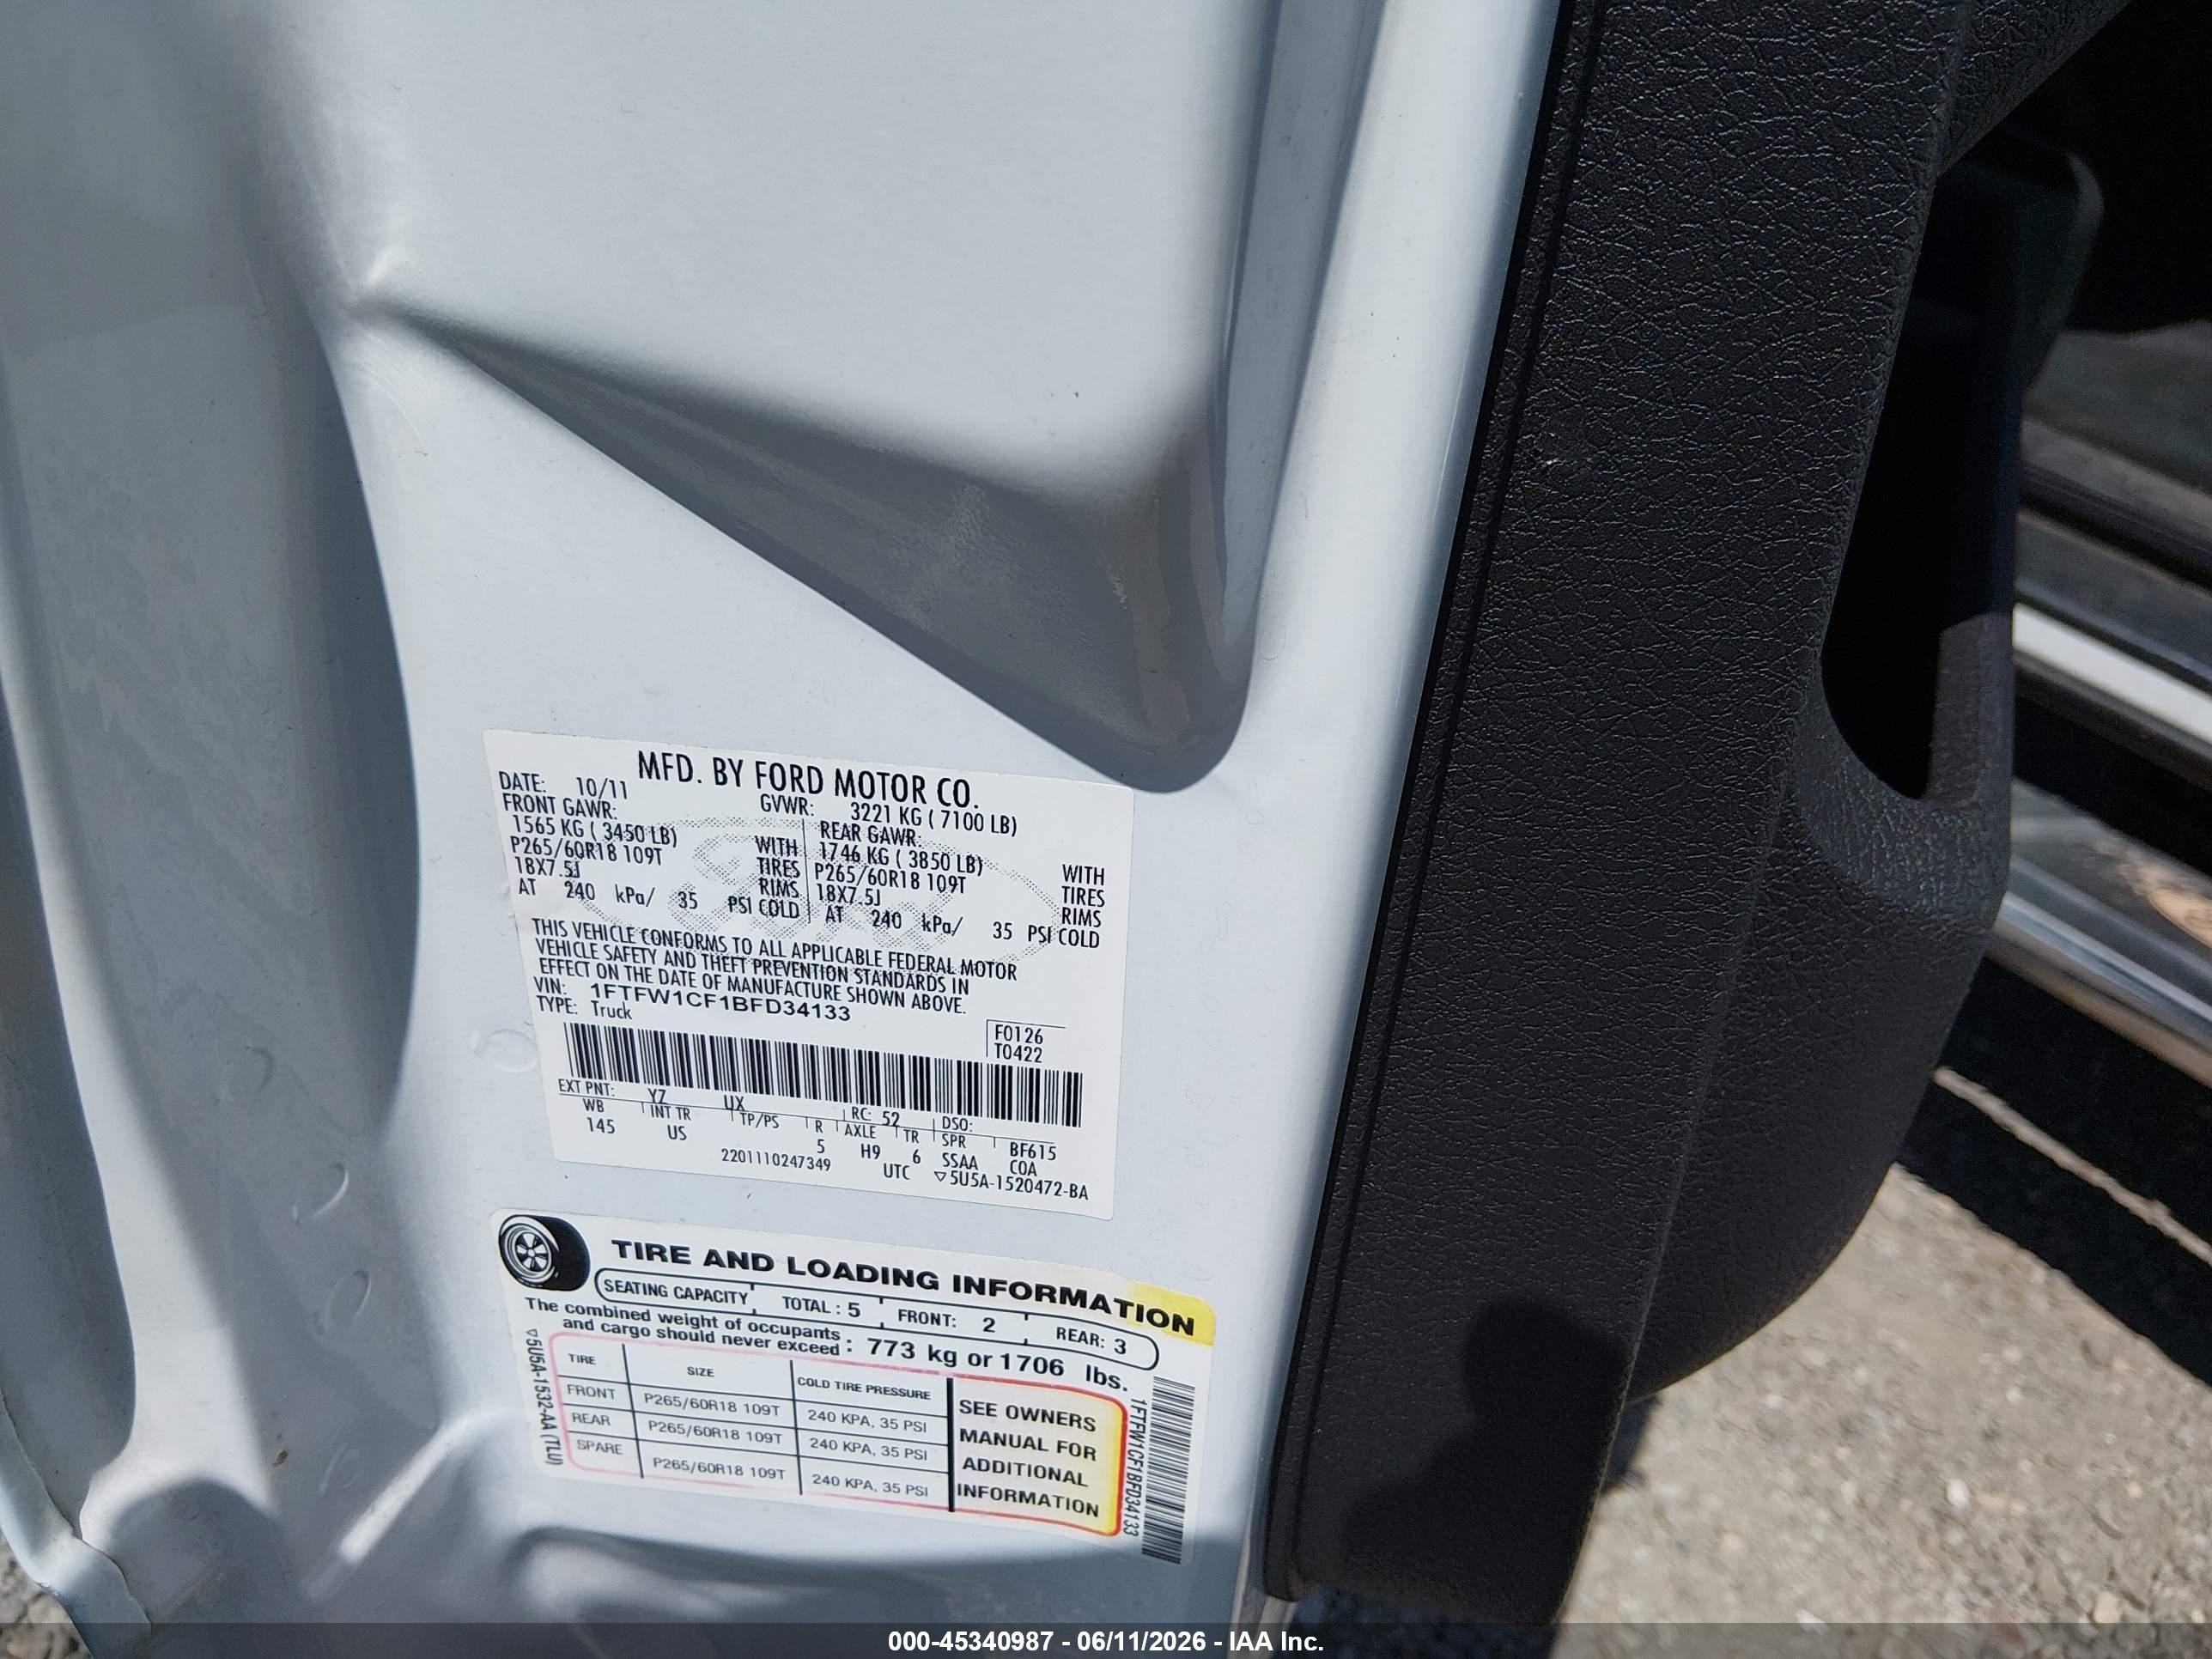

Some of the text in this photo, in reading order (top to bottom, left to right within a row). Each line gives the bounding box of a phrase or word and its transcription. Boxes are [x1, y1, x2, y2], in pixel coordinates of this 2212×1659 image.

[498, 770, 628, 800] DATE: 10/11
[638, 750, 979, 809] MFD. BY FORD MOTOR CO.
[502, 793, 617, 820] FRONT GAWR:
[760, 793, 1017, 837] GVWR: 3221 KG 7100 LB)
[513, 814, 678, 848] 1565 KG 3450 LB)
[820, 820, 921, 848] REAR GAWR:
[510, 836, 662, 866] P265/60R18 109T
[754, 836, 798, 857] WITH
[515, 856, 580, 878] 18X7.5J
[757, 857, 800, 878] TIRES
[820, 842, 983, 876] 1746 KG 3850 LB)
[815, 862, 966, 894] P265/60R18 109T
[1062, 864, 1105, 885] WITH
[519, 878, 799, 918] AT 240 kPa/ 35 PSI COLD
[758, 878, 799, 898] RIMS
[817, 883, 881, 907] 18X7.5J
[1061, 886, 1105, 907] TIRES
[825, 905, 1100, 948] AT 240 kPa/ 35 PSI COLD
[1061, 907, 1102, 928] RIMS
[531, 918, 1018, 981] THIS VEHICLE CONFORMS TO ALL APPLICABLE FEDERAL MOTOR
[535, 938, 969, 996] VEHICLE SAFETY AND THEFT PREVENTION STANDARDS IN
[538, 957, 966, 1015] EFFECT ON THE DATE OF MANUFACTURE SHOWN ABOVE.
[533, 976, 851, 1022] VIN: 1FTFW1CF1BFD34133
[536, 995, 633, 1020] TYPE: Truck
[558, 1079, 616, 1097] EXT PNT:
[583, 1098, 605, 1113] WB
[650, 1104, 692, 1121] INT TR
[851, 1106, 900, 1127] RC: 52
[586, 1117, 616, 1134] 145
[666, 1124, 688, 1141] US
[739, 1112, 780, 1129] TP/PS
[844, 1123, 877, 1139] AXLE
[941, 1116, 974, 1133] DSO:
[903, 1128, 920, 1144] TR
[941, 1133, 967, 1149] SPR
[720, 1147, 831, 1172] 2201110247349
[860, 1143, 881, 1160] H9
[1009, 1141, 1057, 1161] BF615
[884, 1163, 911, 1181] UTC
[950, 1170, 1090, 1200] 5U5A-1520472-BA
[604, 1279, 748, 1305] SEATING CAPACITY
[611, 1239, 1195, 1336] TIRE AND LOADING INFORMATION
[525, 1297, 841, 1341] The combined weight of occupants
[782, 1296, 860, 1318] TOTAL 5
[898, 1309, 996, 1333] FRONT: 2
[1056, 1327, 1127, 1355] REAR: 3
[563, 1316, 1128, 1391] and cargo should never exceed 773 kg or 1706 lbs.
[568, 1353, 596, 1365] TIRE
[687, 1366, 715, 1378] SIZE
[526, 1339, 556, 1431] 5U5A-1532-AA
[567, 1383, 616, 1401] FRONT
[797, 1376, 932, 1401] COLD TIRE PRESSURE
[644, 1393, 781, 1417] P265/60R18 109T
[958, 1399, 1097, 1432] SEE OWNERS
[572, 1412, 611, 1426] REAR
[807, 1409, 927, 1433] 240 KPA, 35 PSI
[648, 1420, 783, 1444] P265/60R18 109T
[576, 1439, 623, 1455] SPARE
[959, 1428, 1097, 1462] MANUAL FOR
[653, 1457, 786, 1480] P265/60R18 109T
[962, 1456, 1089, 1487] ADDITIONAL
[1123, 1398, 1148, 1537] 1FTFW1CF1BFD34133
[957, 1483, 1099, 1518] INFORMATION
